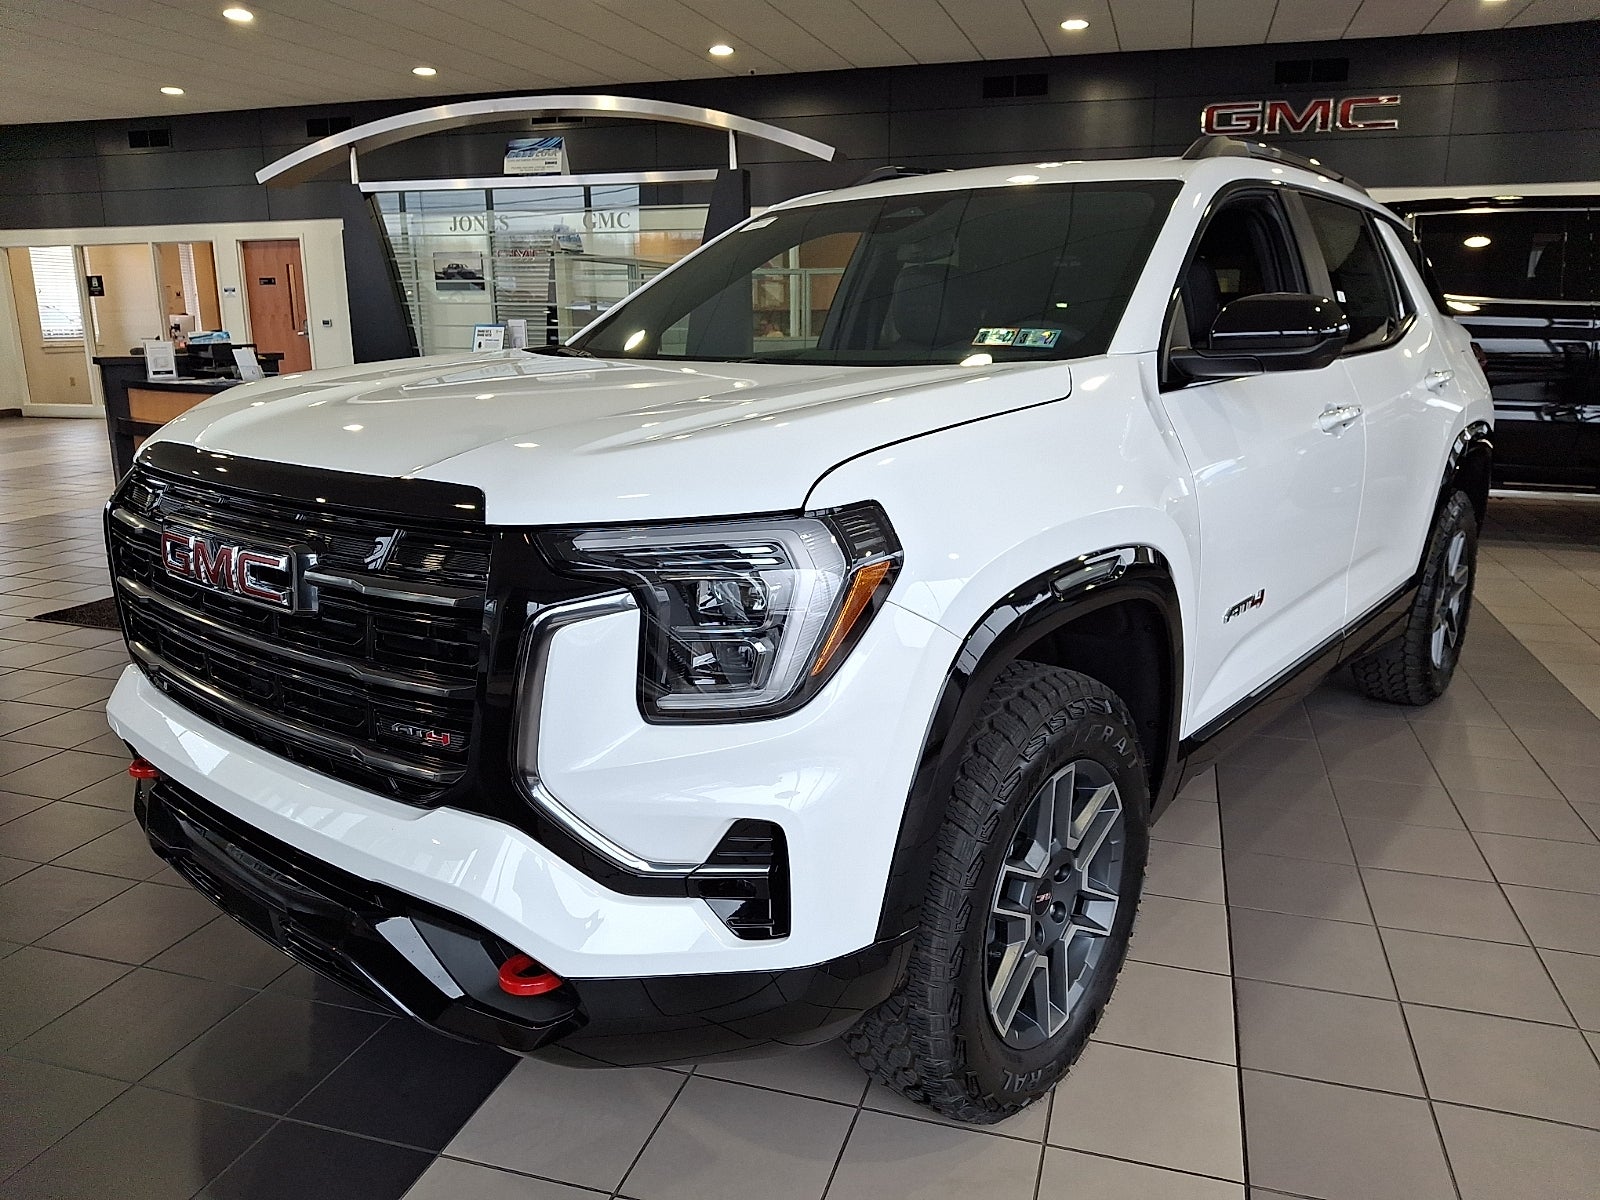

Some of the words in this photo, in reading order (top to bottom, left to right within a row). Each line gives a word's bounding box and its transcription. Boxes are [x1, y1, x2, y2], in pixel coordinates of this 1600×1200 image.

[1201, 95, 1401, 137] GMC
[582, 211, 632, 229] GMC
[161, 530, 293, 607] GMC
[1223, 588, 1265, 624] AT4
[391, 723, 451, 746] AT4
